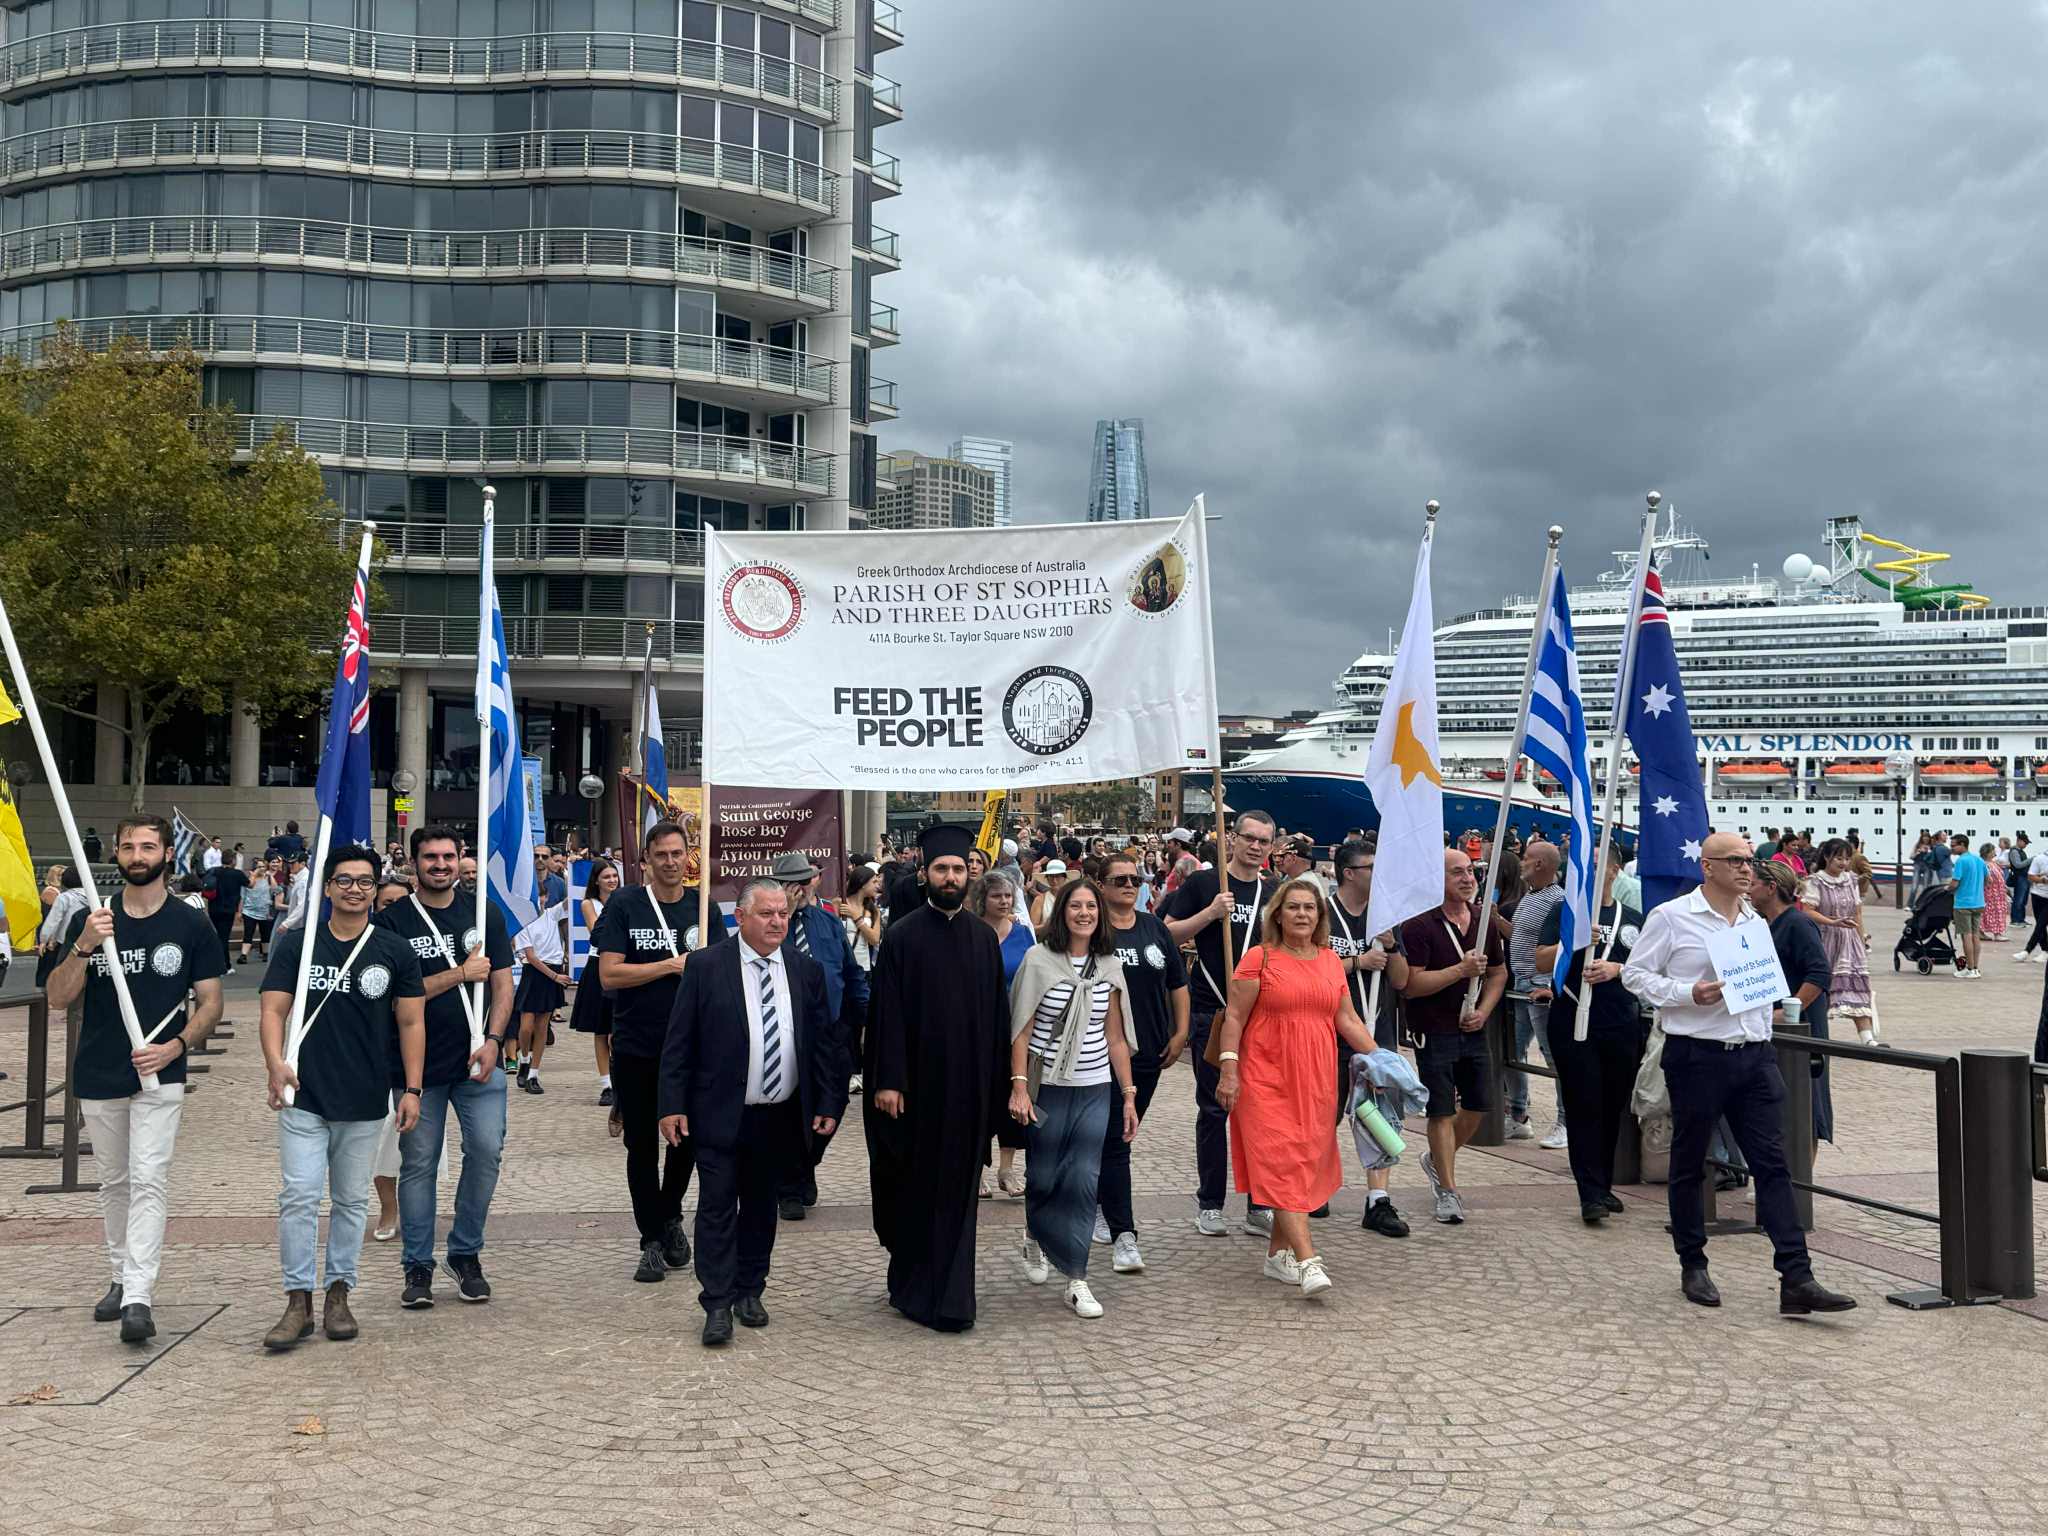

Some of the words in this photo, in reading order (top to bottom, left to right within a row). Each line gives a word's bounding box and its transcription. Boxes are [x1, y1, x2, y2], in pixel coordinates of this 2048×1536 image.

[857, 565, 891, 578] Greek
[893, 564, 945, 577] Orthodox
[948, 563, 1018, 576] Archdiocese
[1021, 561, 1033, 574] of
[1036, 559, 1086, 574] Australia
[832, 584, 926, 603] PARISH
[934, 583, 968, 601] OF
[977, 581, 1006, 601] ST
[1013, 576, 1110, 599] SOPHIA
[831, 606, 882, 624] AND
[888, 606, 966, 624] THREE
[973, 597, 1112, 621] DAUGHTERS
[869, 632, 891, 644] 411A
[893, 632, 930, 644] Bourke
[950, 631, 981, 645] Taylor
[984, 630, 1020, 643] Square
[1023, 627, 1047, 639] NSW
[1049, 625, 1073, 638] 2010
[833, 687, 913, 715] FEED
[919, 686, 982, 716] THE
[857, 718, 984, 747] PEOPLE
[1033, 745, 1053, 754] THE
[1760, 734, 1914, 751] SPLENDOR
[892, 766, 900, 775] is
[902, 766, 917, 775] the
[938, 767, 957, 775] who
[960, 767, 984, 775] cares
[986, 765, 999, 775] for
[1001, 766, 1016, 775] the
[720, 810, 760, 822] Saint
[763, 809, 813, 822] George
[720, 825, 756, 837] Rose
[760, 824, 788, 838] Bay
[1235, 903, 1254, 914] THE
[629, 928, 655, 939] FEED
[1741, 935, 1749, 950] 4
[120, 948, 146, 962] THE
[1116, 948, 1136, 957] THE
[1722, 966, 1743, 978] Parish
[1743, 962, 1750, 972] of
[1733, 981, 1745, 990] her
[1745, 977, 1750, 986] 3
